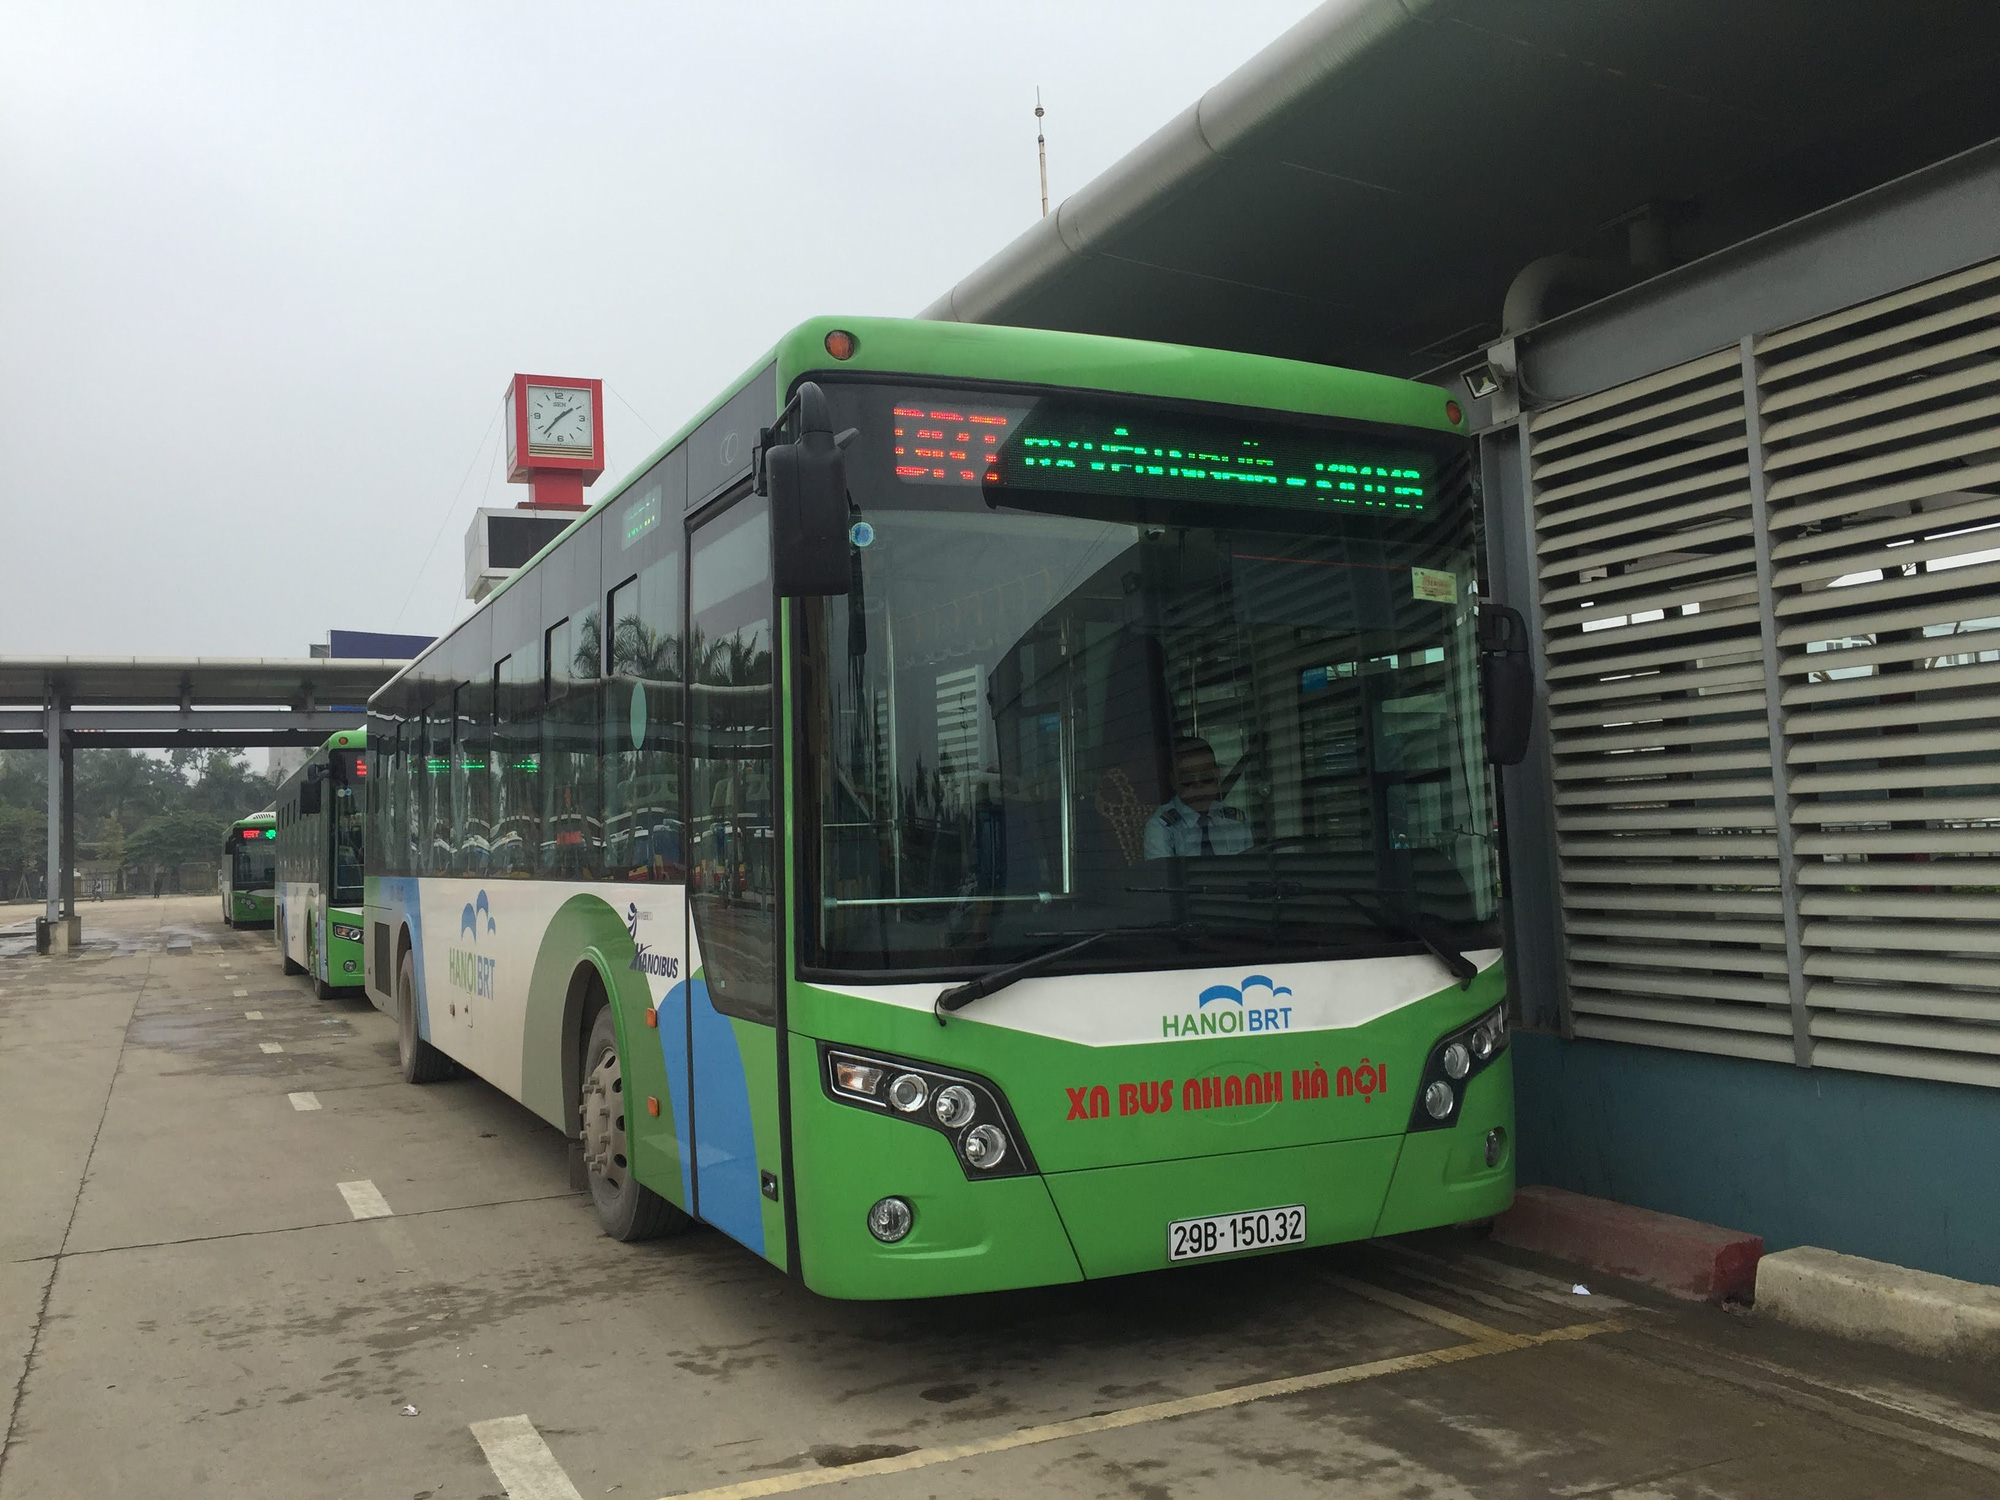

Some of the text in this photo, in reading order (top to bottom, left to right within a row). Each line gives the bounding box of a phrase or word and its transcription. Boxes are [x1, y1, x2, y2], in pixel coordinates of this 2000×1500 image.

[1118, 1079, 1174, 1117] BUS
[1182, 1071, 1283, 1111] NHANH
[1292, 1061, 1329, 1100] HÀ
[1336, 1058, 1387, 1104] NỘI
[1173, 1209, 1302, 1257] 29B-150.32
